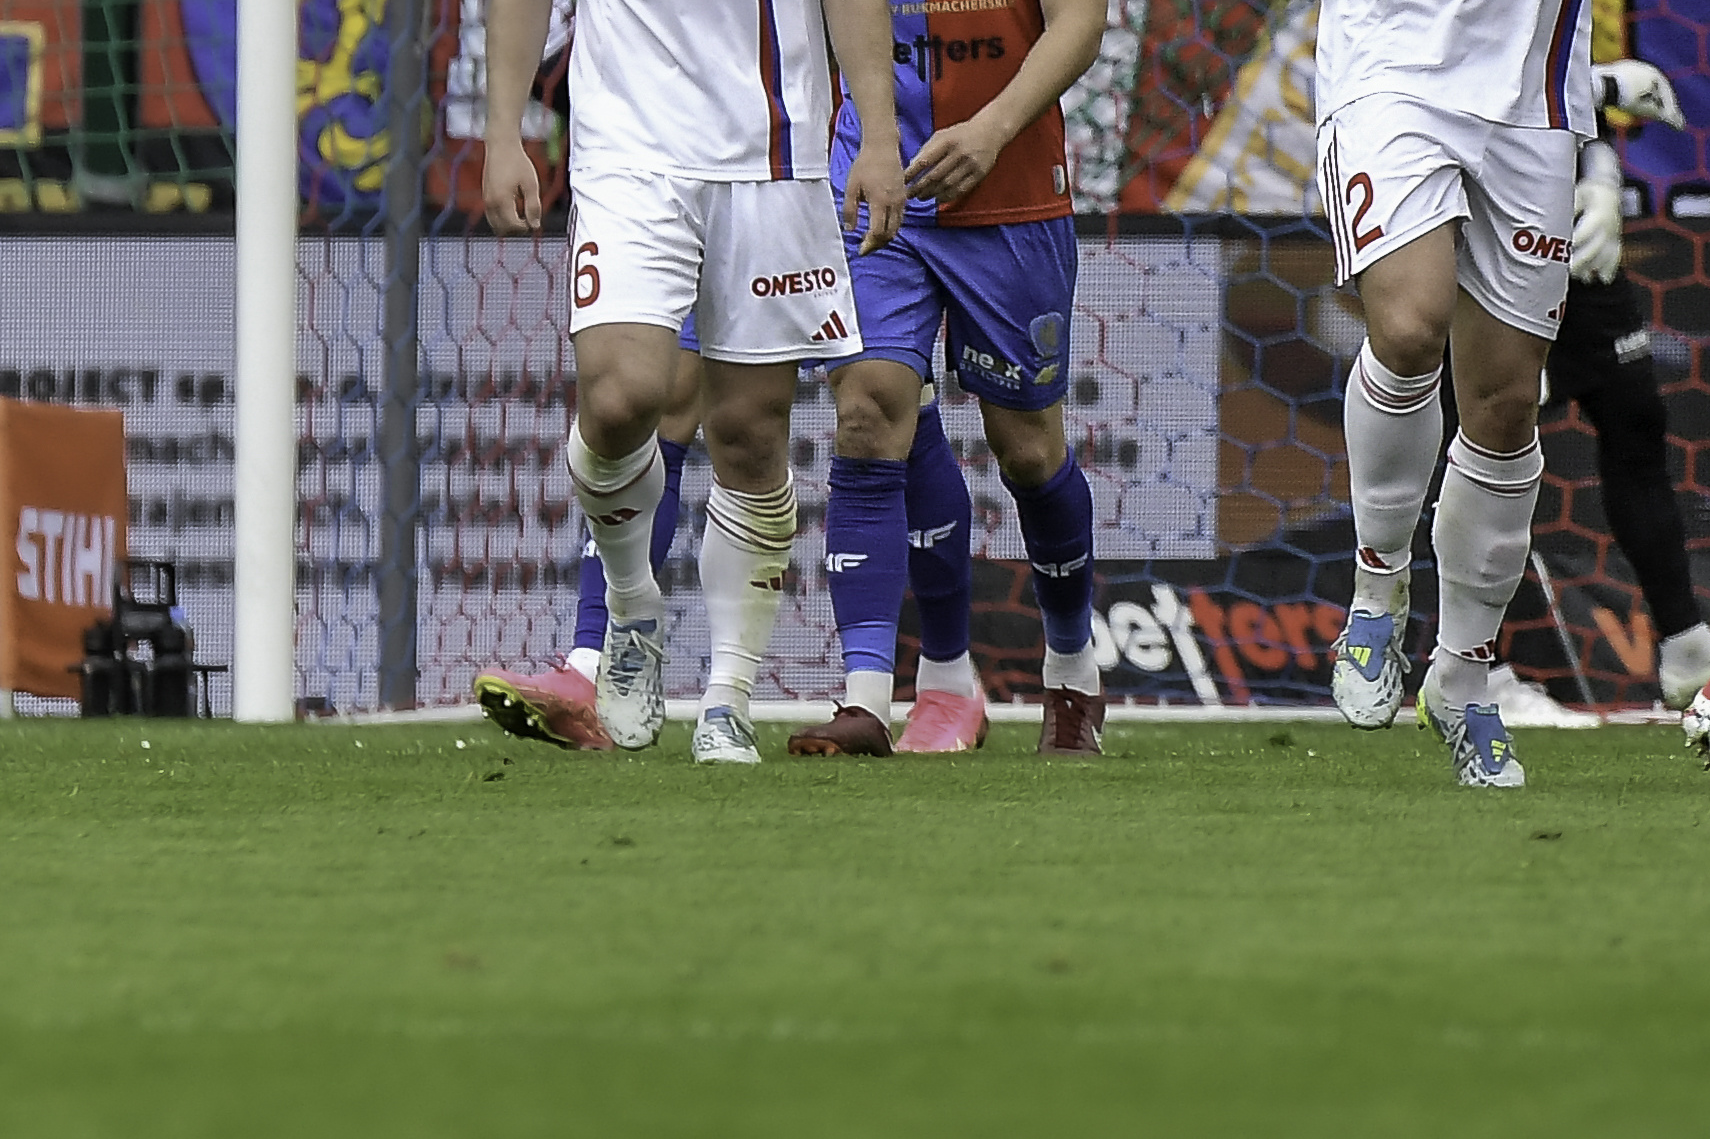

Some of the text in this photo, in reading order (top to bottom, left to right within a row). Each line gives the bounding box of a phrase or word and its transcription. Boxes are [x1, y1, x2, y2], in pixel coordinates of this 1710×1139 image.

[892, 34, 1006, 83] etters
[1345, 171, 1383, 255] 2
[1512, 229, 1572, 263] ONES
[570, 240, 601, 309] 6
[751, 266, 836, 296] ONESTO
